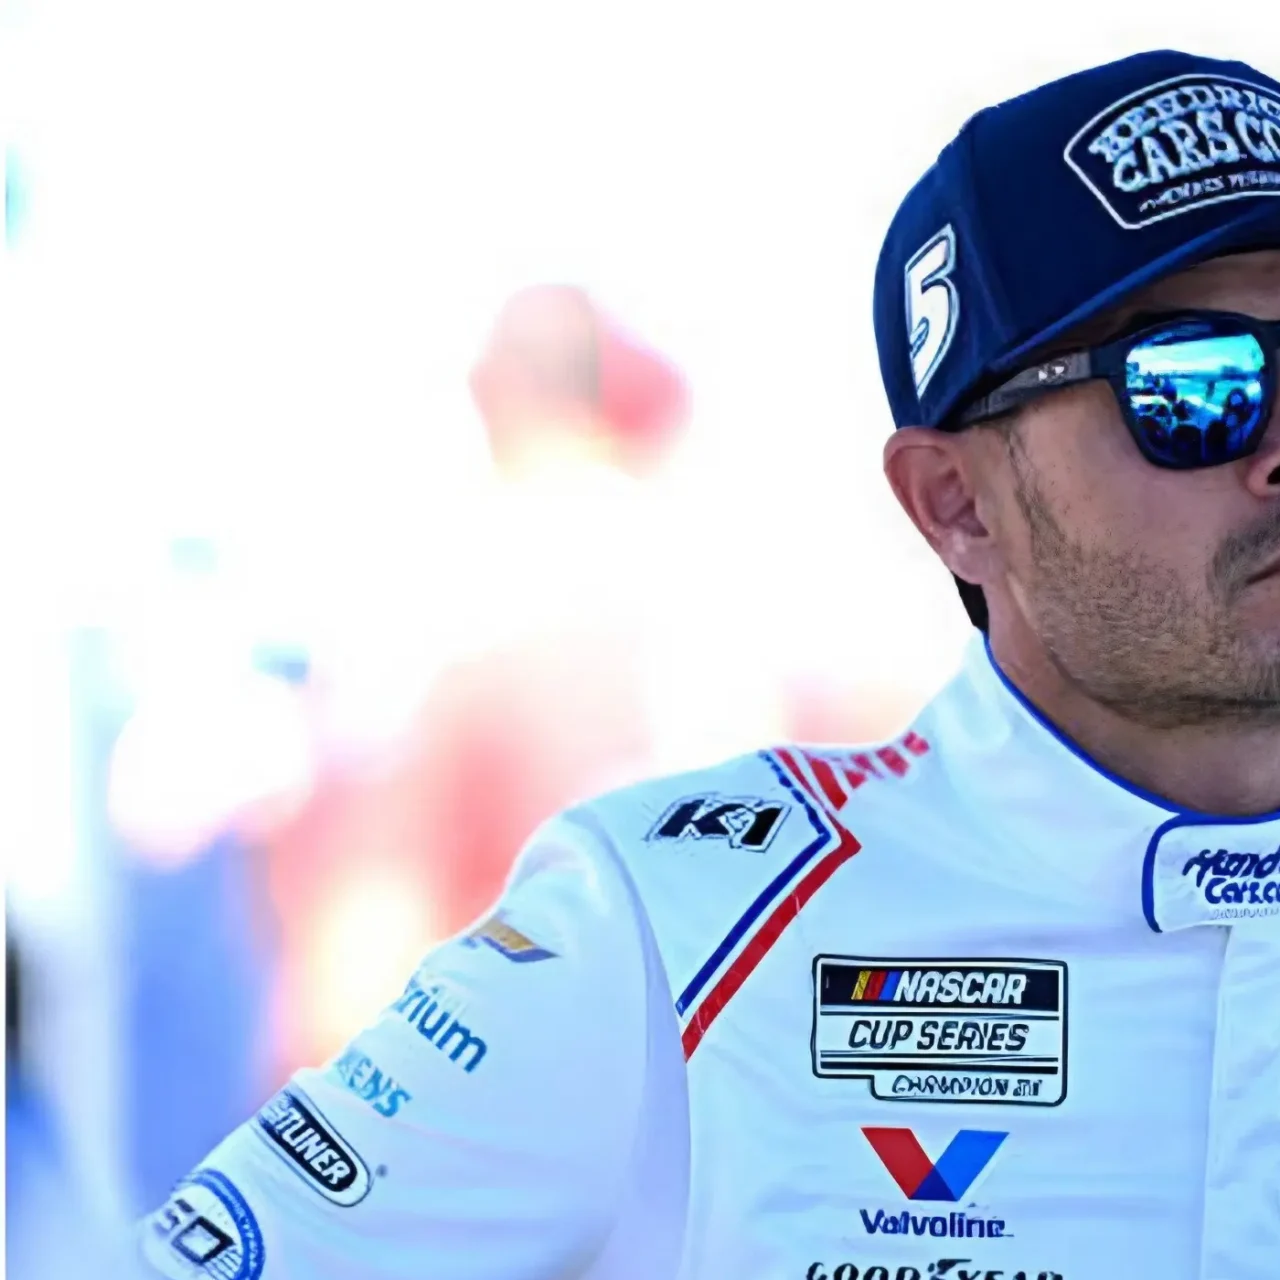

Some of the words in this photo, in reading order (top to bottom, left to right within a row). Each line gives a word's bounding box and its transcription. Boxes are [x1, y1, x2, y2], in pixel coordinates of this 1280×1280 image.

[905, 224, 960, 399] 5
[893, 970, 1027, 1004] NASCAR
[848, 1020, 913, 1050] CUP
[859, 1208, 1006, 1238] Valvoline
